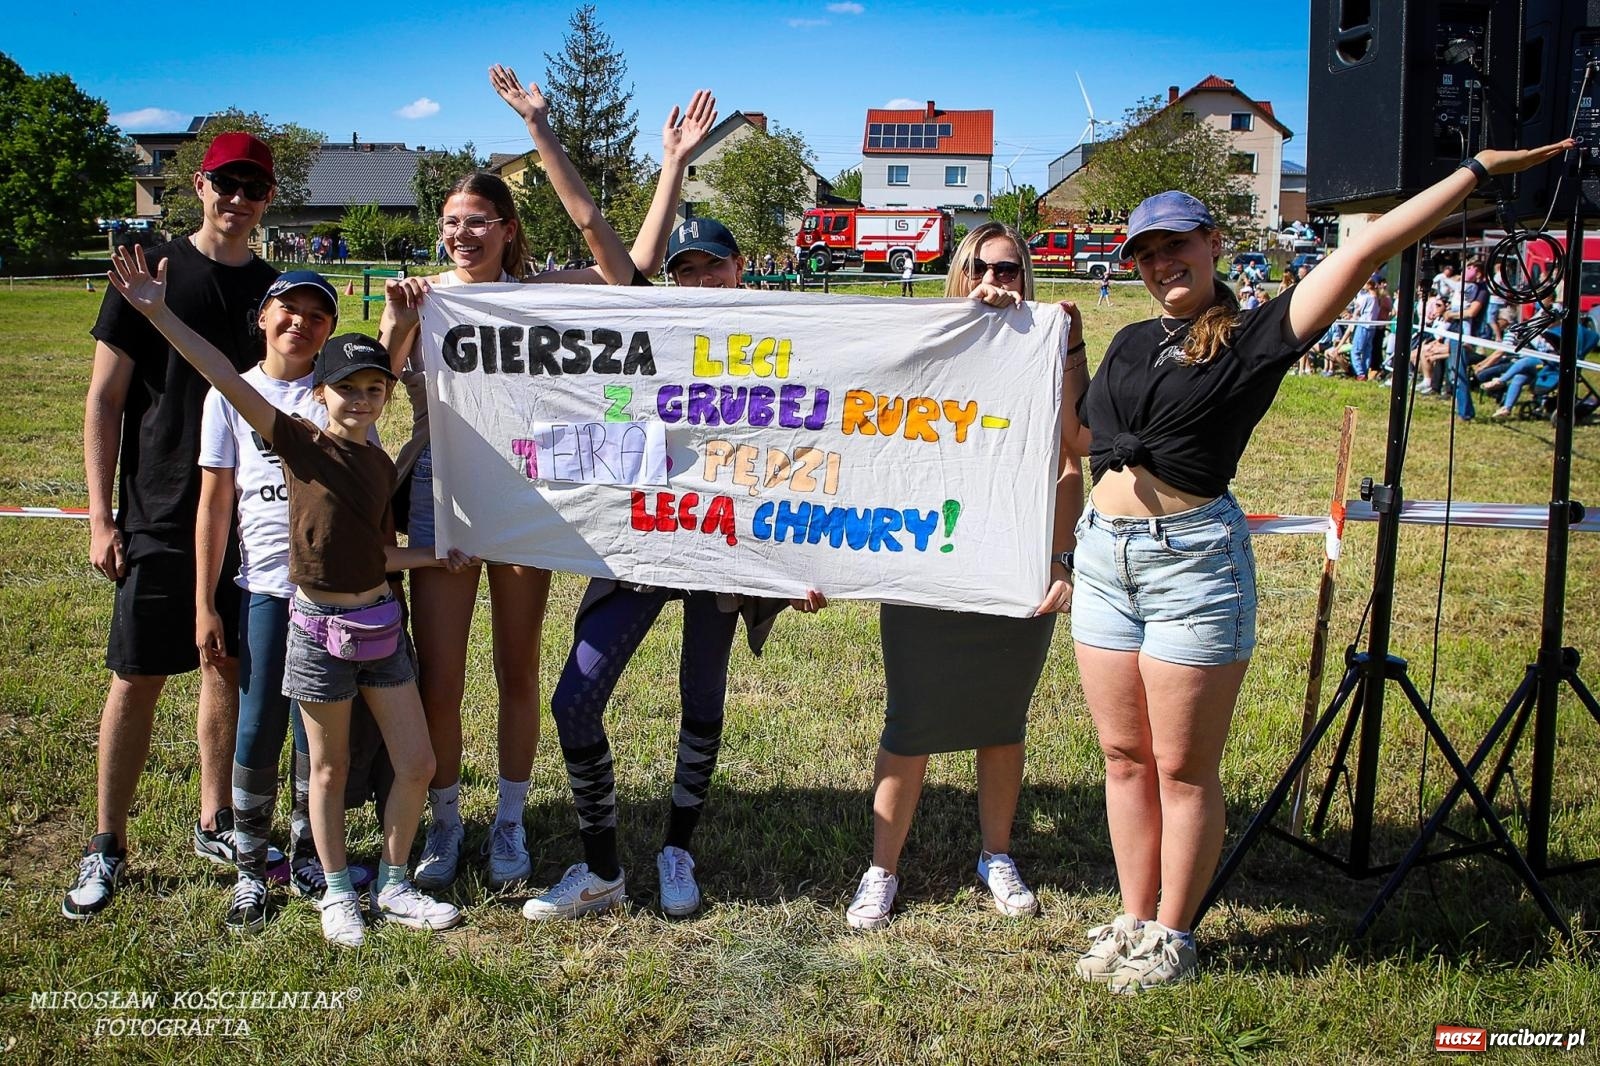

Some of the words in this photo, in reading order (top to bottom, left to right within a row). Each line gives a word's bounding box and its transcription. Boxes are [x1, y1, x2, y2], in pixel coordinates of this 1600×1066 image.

[442, 324, 657, 376] GIERSZA
[693, 334, 792, 379] LECI
[604, 385, 632, 422] Z
[657, 383, 829, 430] GRUBEJ
[703, 439, 839, 496] PĘDZI
[631, 489, 737, 546] LECĄ
[752, 499, 962, 553] CHMURY!
